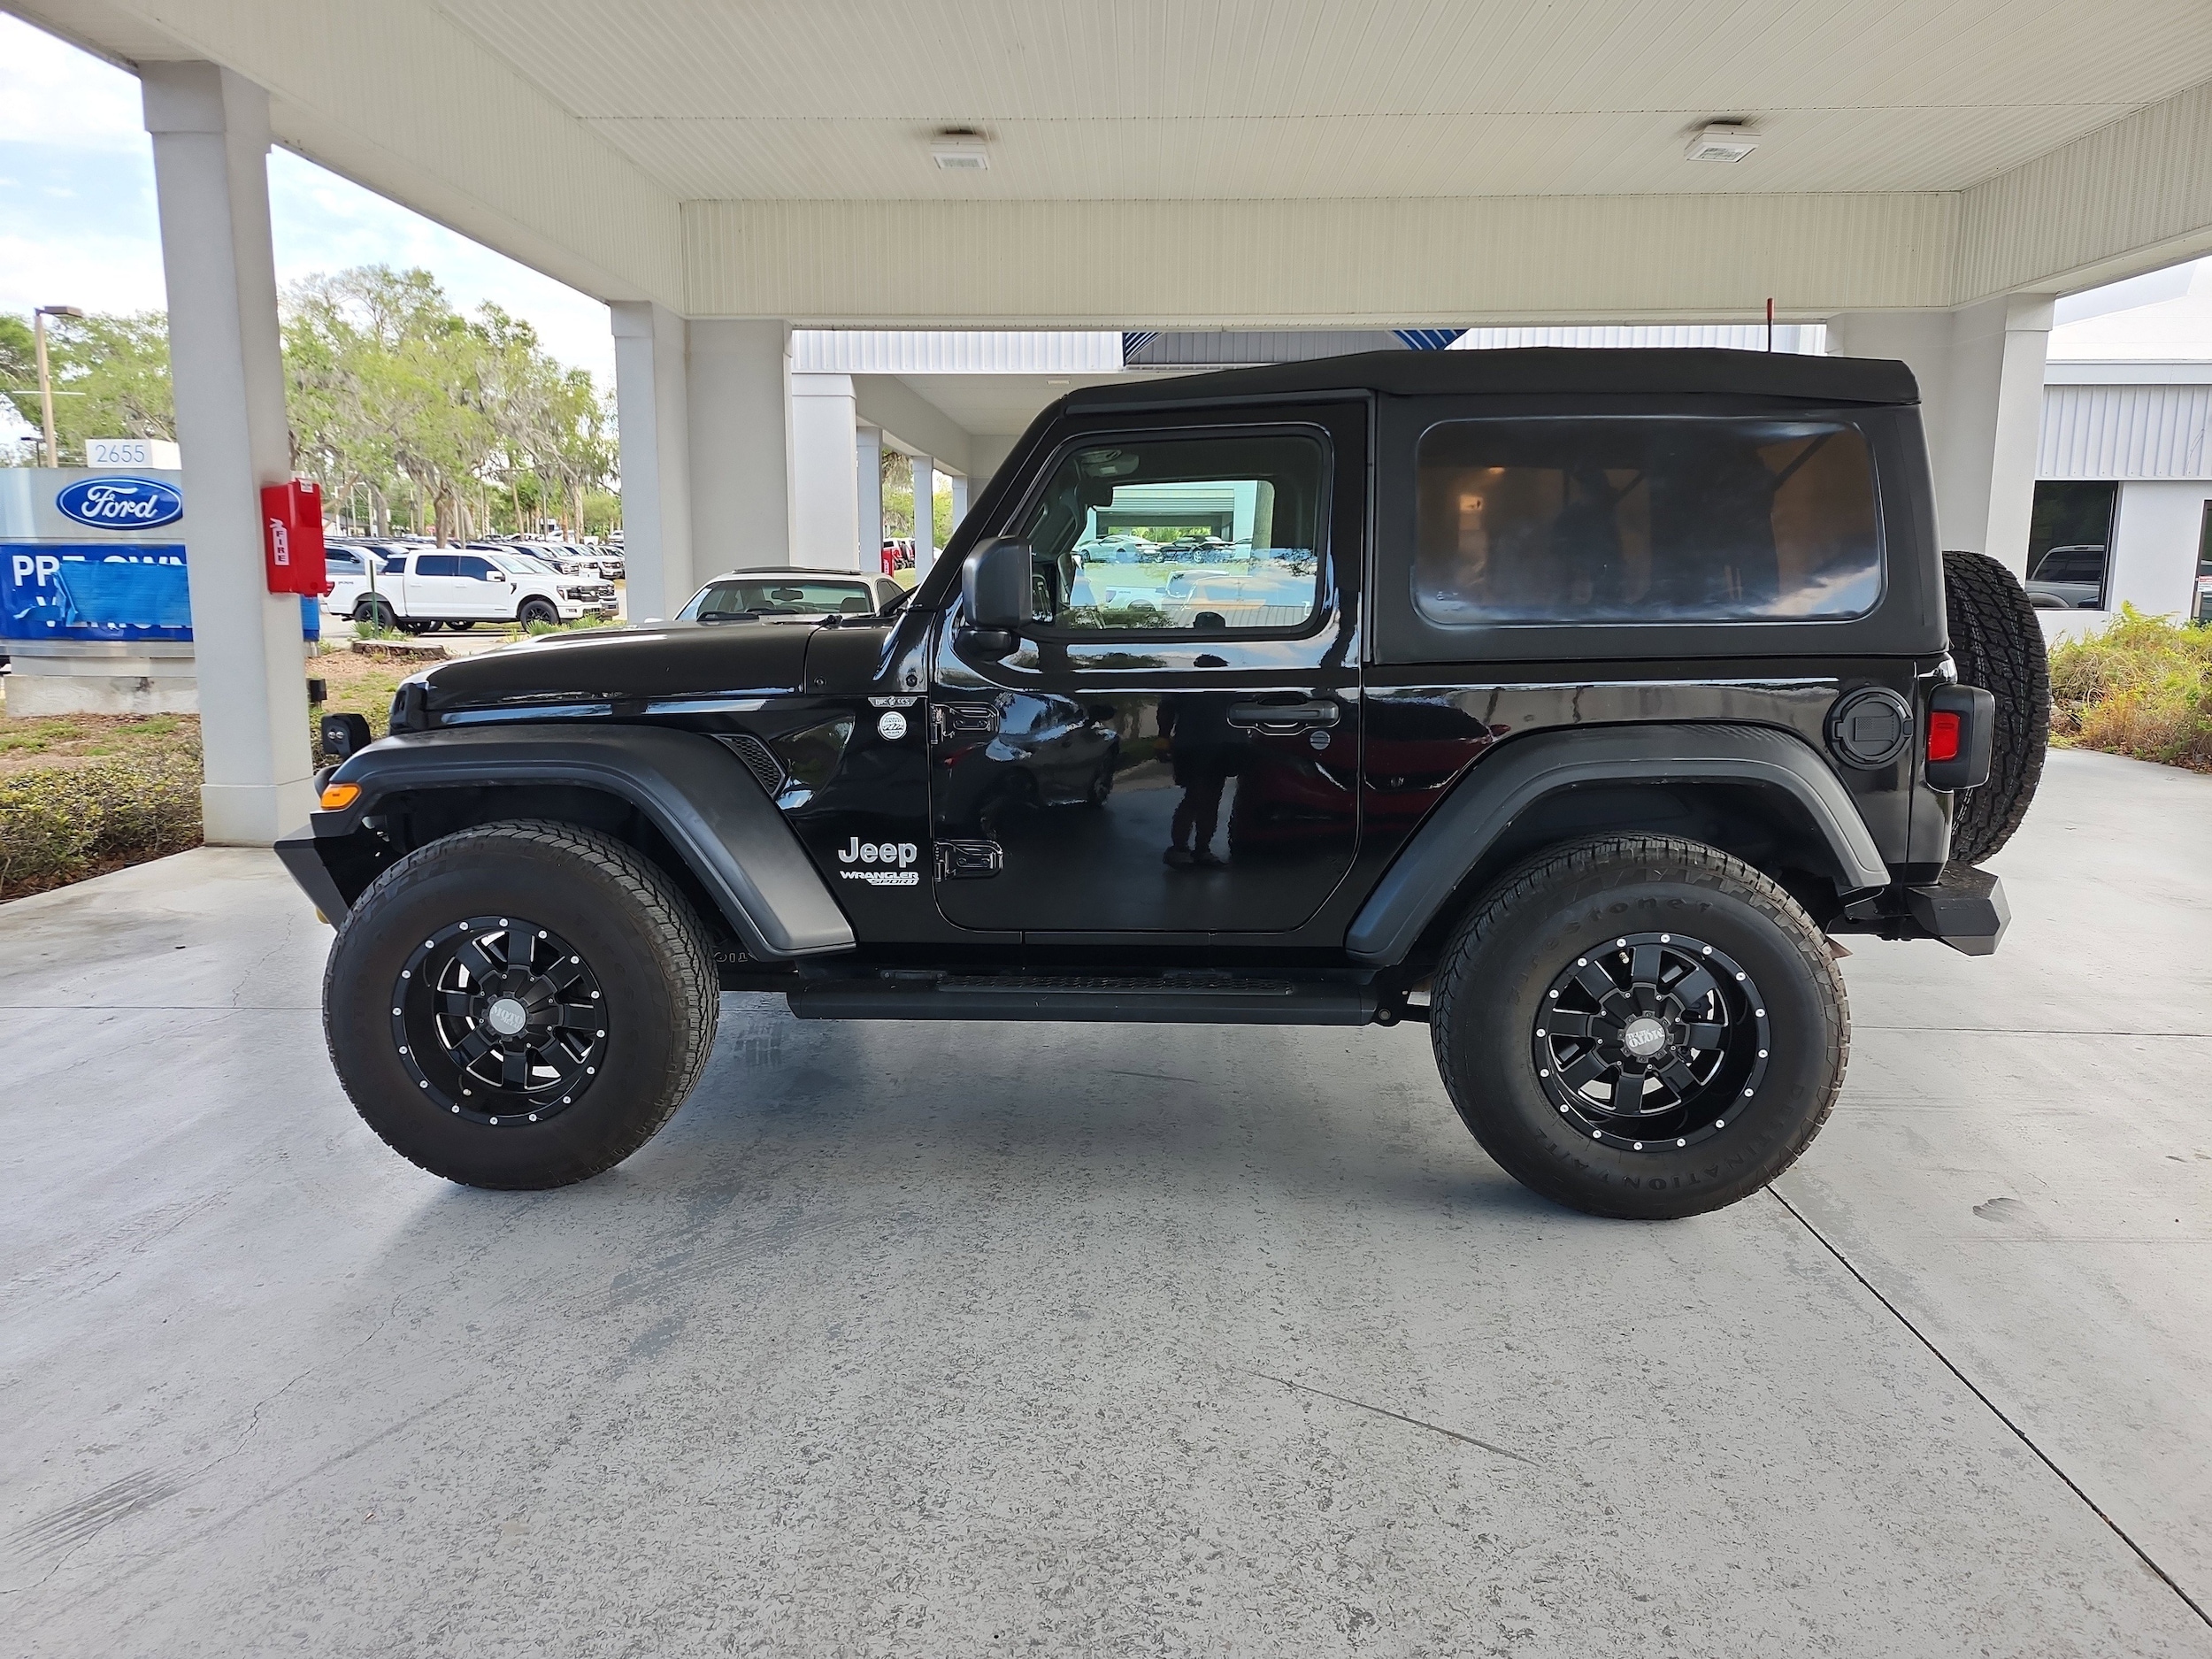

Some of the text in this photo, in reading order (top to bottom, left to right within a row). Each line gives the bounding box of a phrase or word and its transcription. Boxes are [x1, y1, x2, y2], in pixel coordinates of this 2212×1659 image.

[95, 444, 145, 463] 2655
[81, 485, 158, 518] Ford
[275, 530, 287, 563] FIRE
[837, 836, 918, 868] Jeep
[839, 870, 919, 879] WRANGLER
[489, 1003, 524, 1025] MOTO
[1628, 1027, 1665, 1048] MOTO
